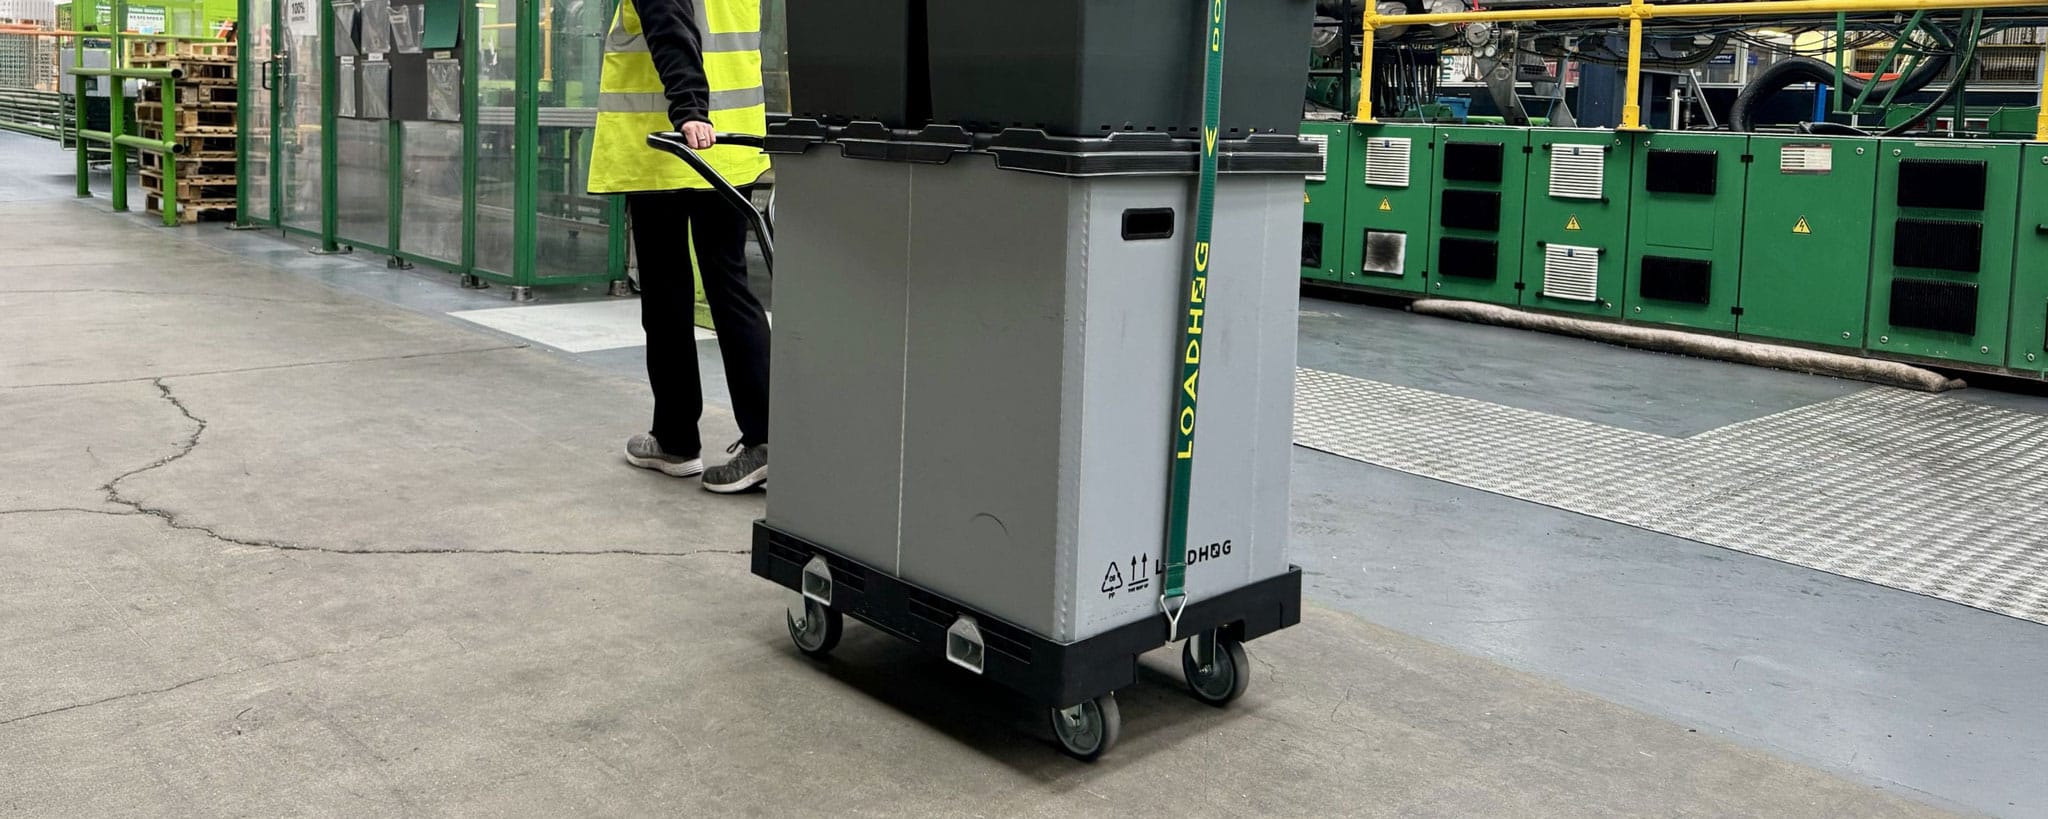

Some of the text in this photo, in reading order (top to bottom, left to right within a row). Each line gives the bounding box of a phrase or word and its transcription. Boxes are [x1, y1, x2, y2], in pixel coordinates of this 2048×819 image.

[291, 2, 305, 14] 100%
[1177, 241, 1209, 459] LOADHOG
[1155, 540, 1232, 575] LDHOG
